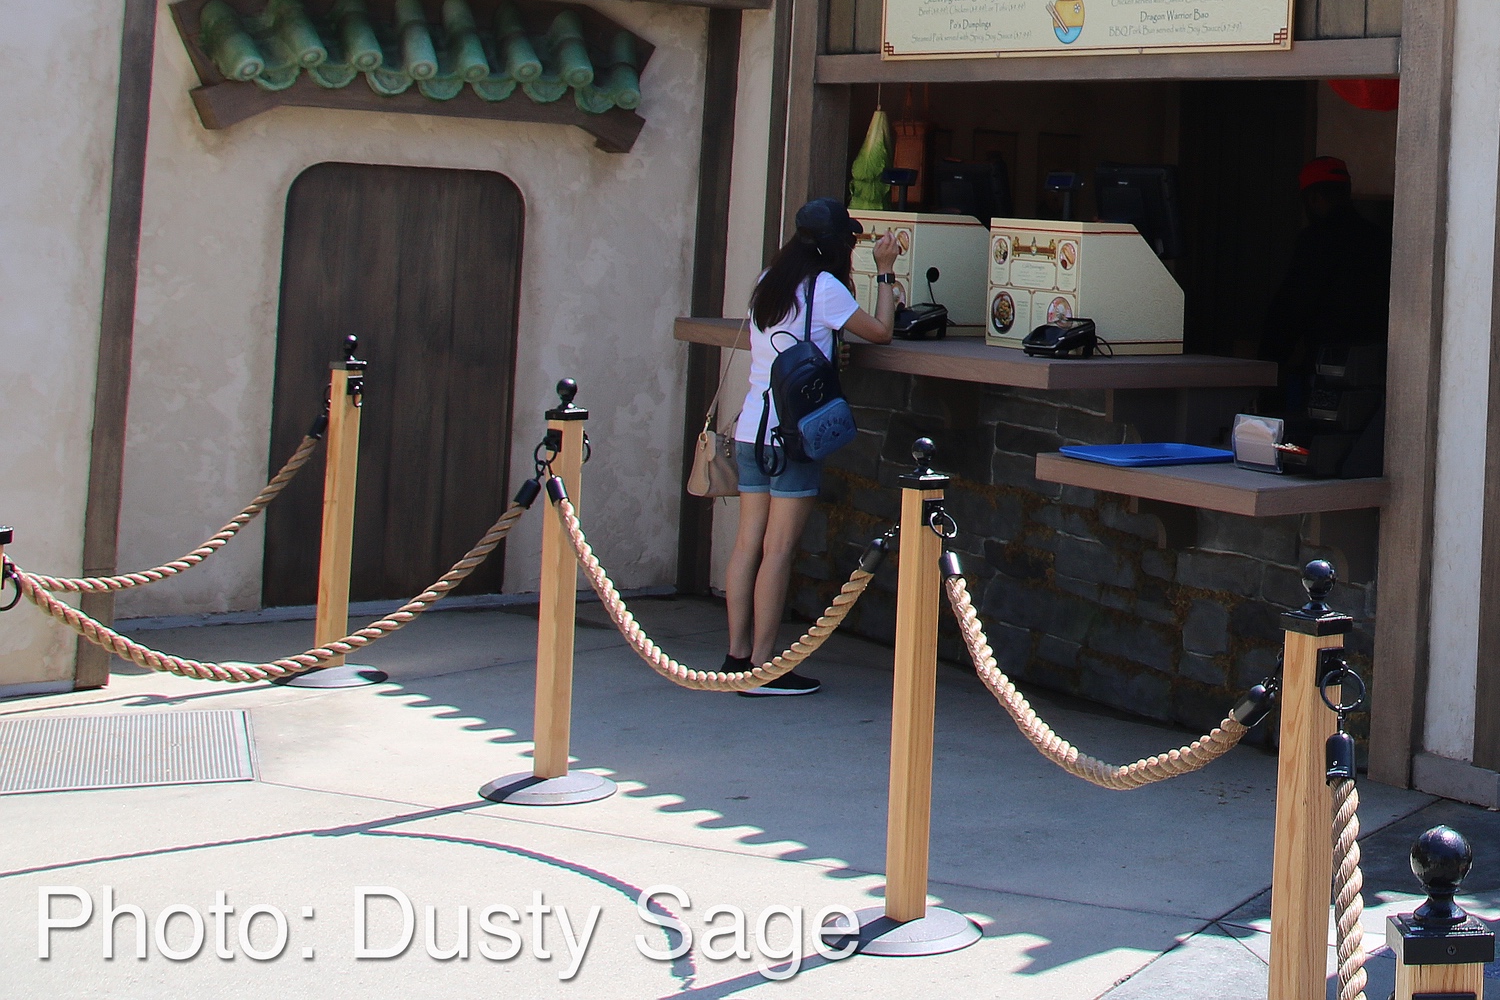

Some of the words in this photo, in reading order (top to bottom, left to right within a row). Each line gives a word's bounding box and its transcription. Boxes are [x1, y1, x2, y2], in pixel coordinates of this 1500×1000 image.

[1140, 10, 1165, 24] Dragon
[1166, 9, 1193, 21] Warrior
[1193, 8, 1210, 21] Bao
[949, 19, 962, 31] Po's
[962, 18, 992, 31] Dumplings
[1109, 25, 1128, 37] BBQ
[1128, 24, 1141, 36] Pork
[1142, 24, 1155, 36] Bun
[1155, 24, 1175, 35] served
[1175, 23, 1186, 33] with
[1187, 22, 1200, 36] Soy
